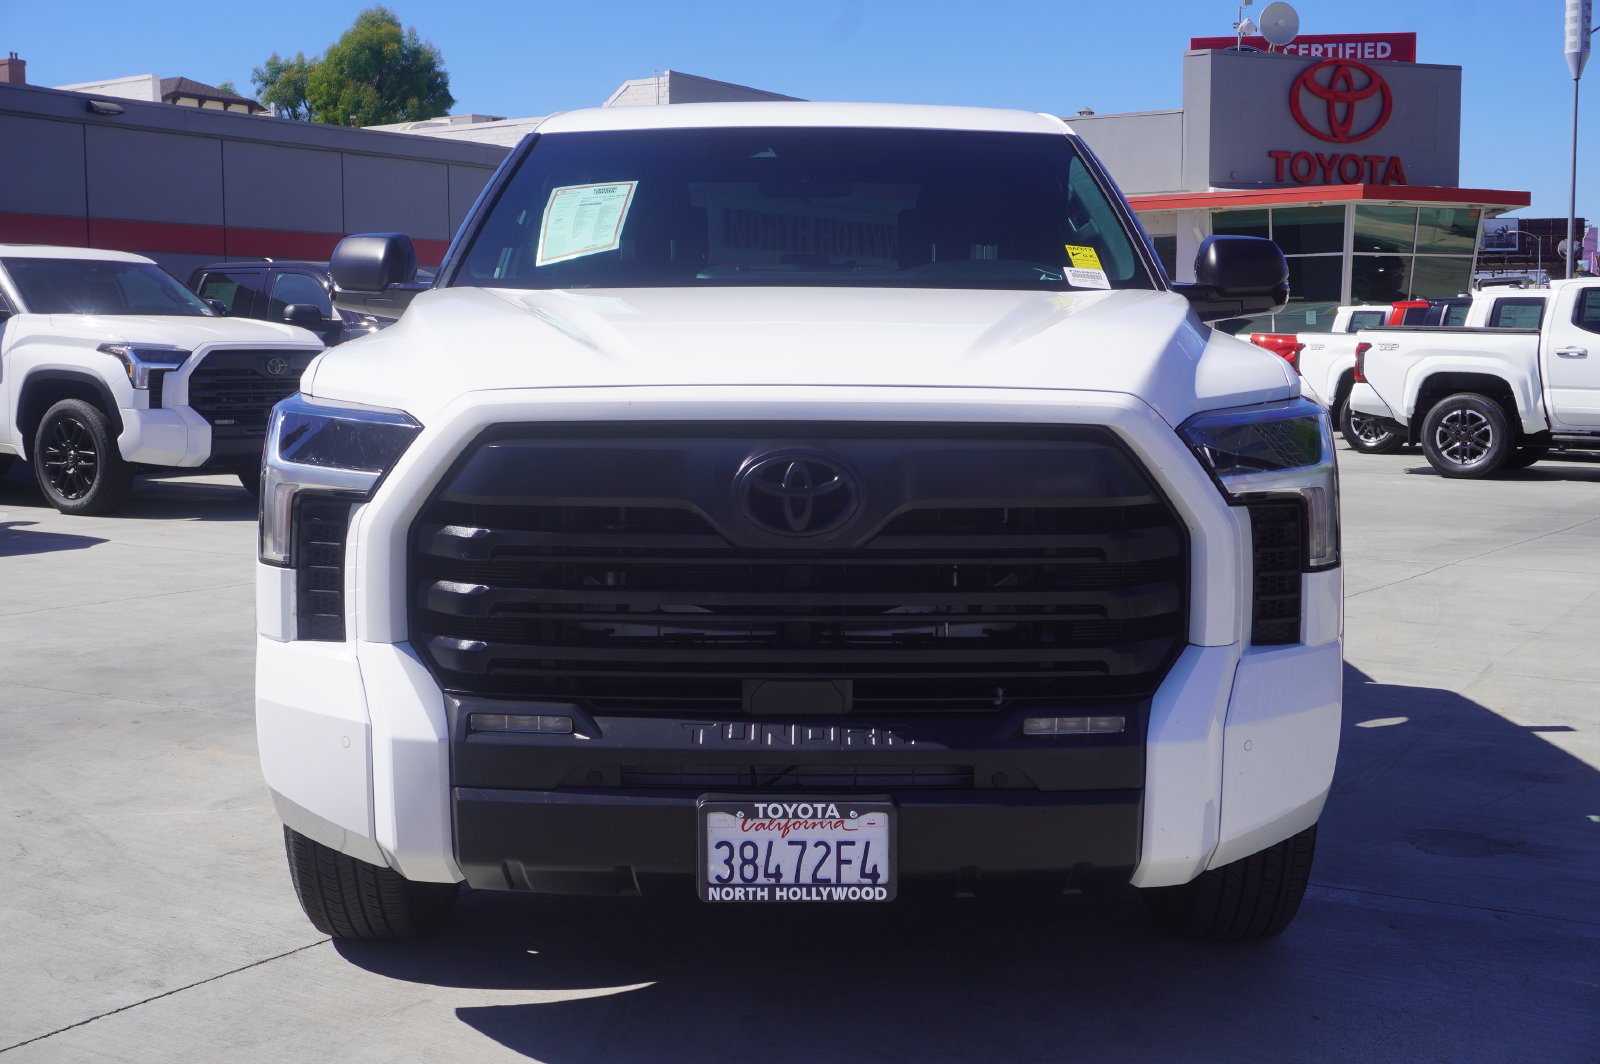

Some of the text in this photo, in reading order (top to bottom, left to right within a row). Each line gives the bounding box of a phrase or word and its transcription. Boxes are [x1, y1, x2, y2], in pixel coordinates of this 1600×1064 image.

[1285, 42, 1392, 59] CERTIFIED
[1269, 152, 1407, 185] TOYOTA
[754, 803, 840, 819] TOYOTA
[741, 818, 858, 839] California
[714, 840, 881, 884] 38472F4
[708, 887, 887, 901] NORTH HOLLYWOOD
